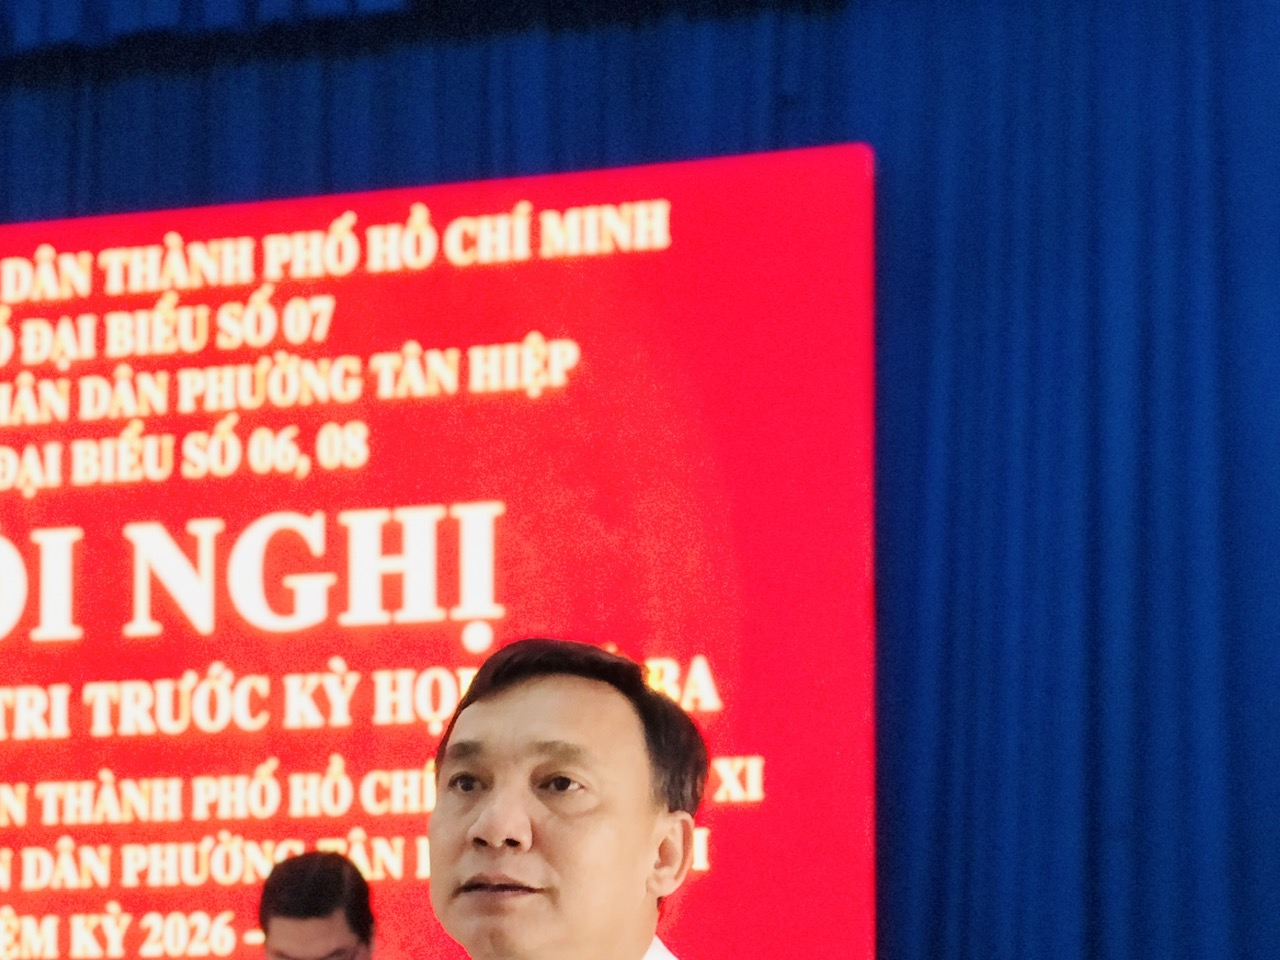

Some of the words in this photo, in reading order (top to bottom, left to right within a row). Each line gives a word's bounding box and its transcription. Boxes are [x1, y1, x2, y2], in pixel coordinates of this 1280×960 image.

[0, 245, 92, 302] DÂN
[99, 233, 254, 295] THÀNH
[264, 213, 359, 280] PHỐ
[367, 204, 437, 272] HỒ
[444, 202, 530, 265] CHÍ
[540, 201, 669, 258] MINH
[20, 315, 96, 371] ĐẠI
[217, 282, 276, 349] SỐ
[283, 296, 334, 344] 07
[78, 364, 169, 421] DÂN
[178, 351, 362, 413] PHƯỜNG
[370, 341, 459, 399] TÂN
[469, 332, 579, 398] HIỆP
[182, 412, 242, 478] SỐ
[248, 426, 310, 478] 06,
[316, 421, 369, 469] 08
[124, 501, 505, 654] NGHỊ
[83, 662, 269, 737] TRƯỚC
[283, 657, 360, 729] KỲ
[35, 769, 183, 825] THÀNH
[192, 758, 281, 821] PHỐ
[289, 754, 354, 818] HỒ
[711, 756, 765, 802] XI
[21, 836, 111, 891] DÂN
[70, 901, 132, 959] KỲ
[139, 911, 236, 958] 2026
